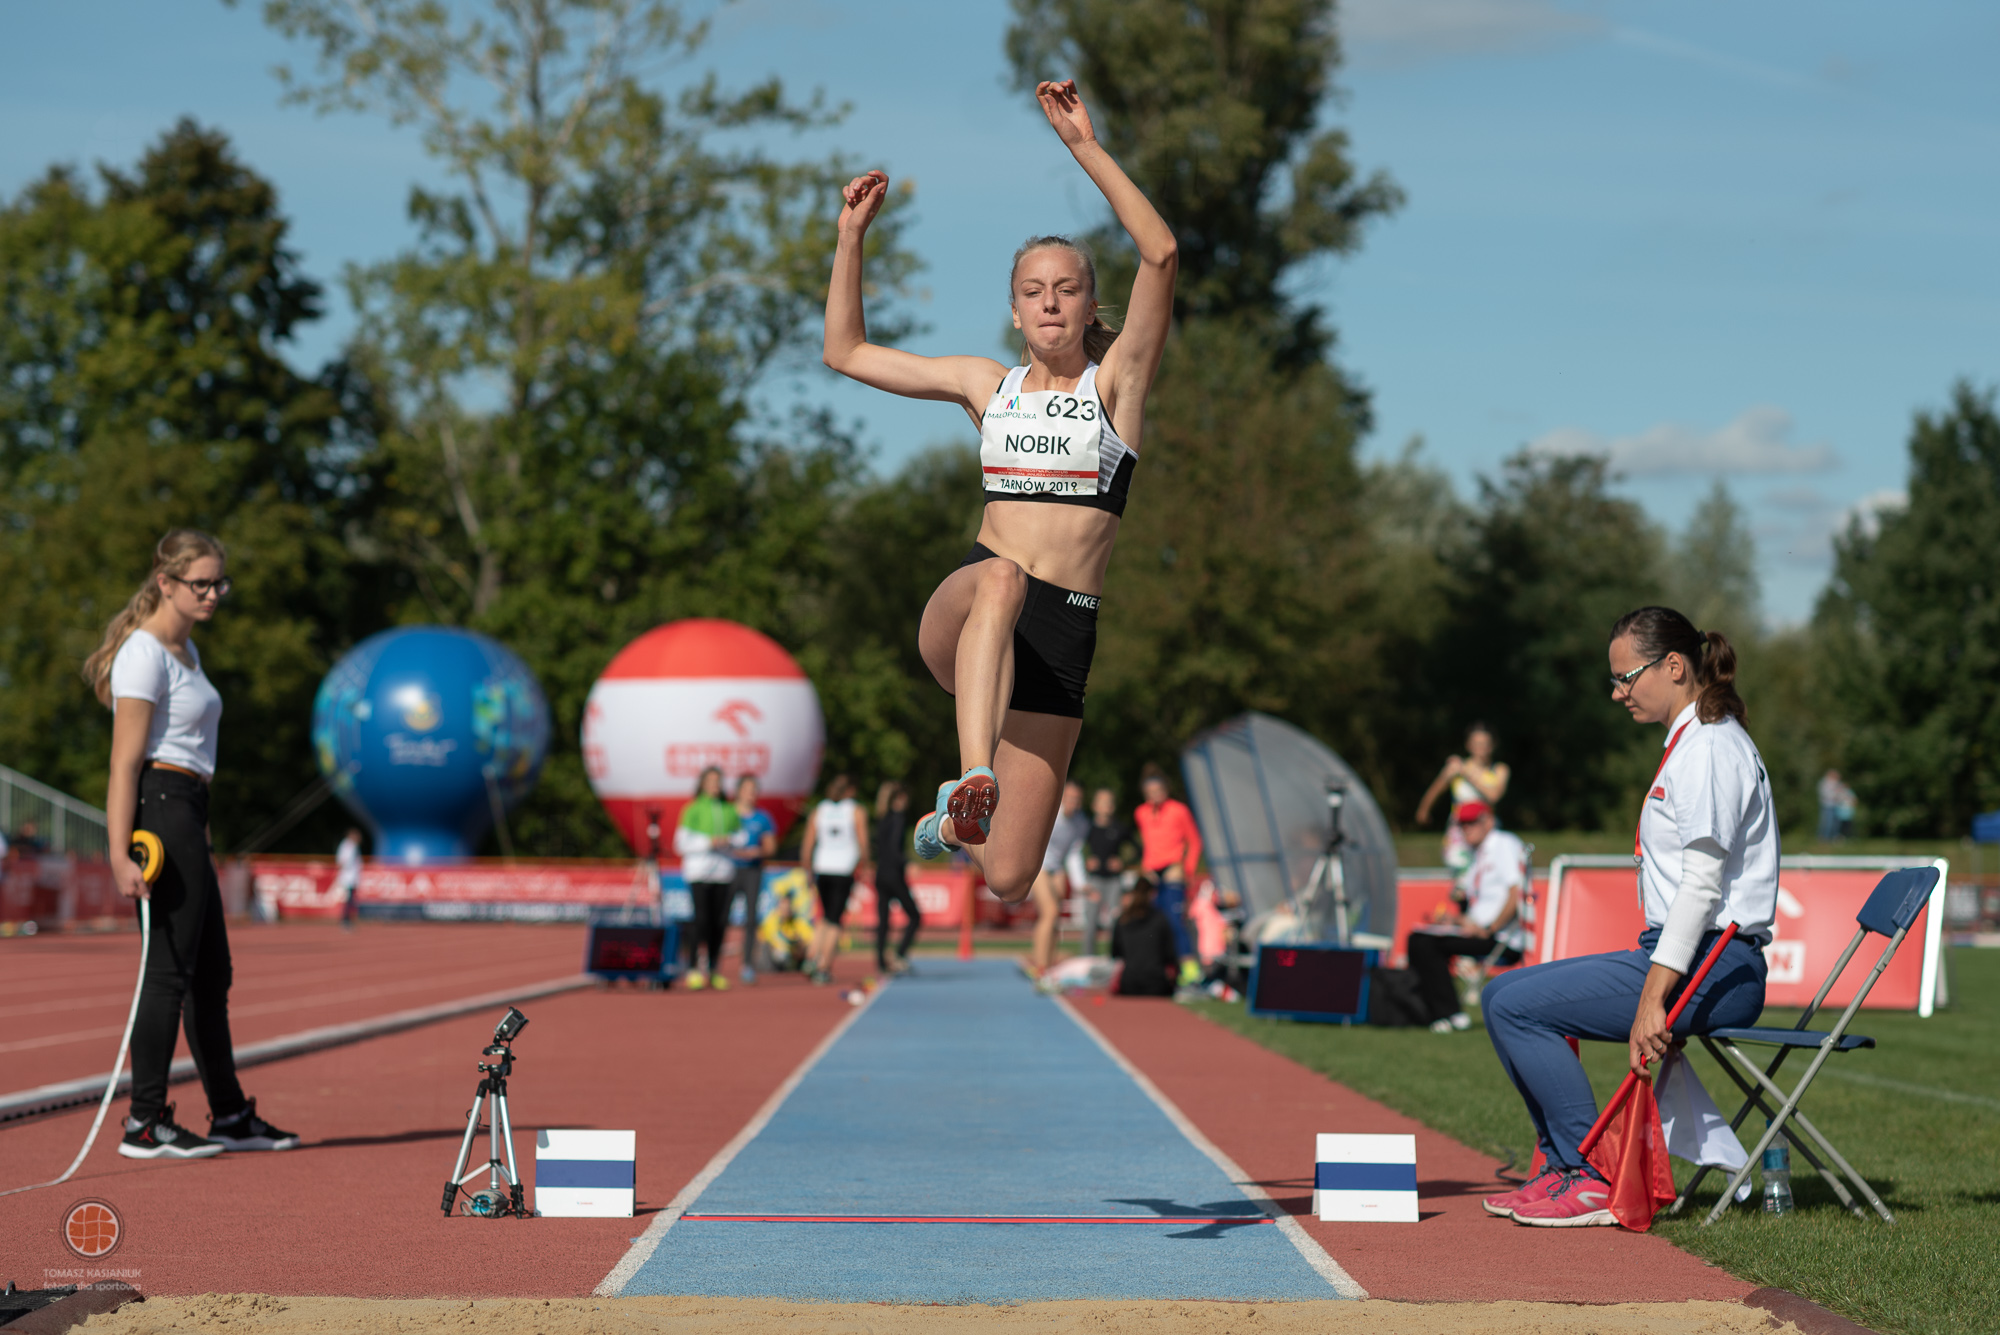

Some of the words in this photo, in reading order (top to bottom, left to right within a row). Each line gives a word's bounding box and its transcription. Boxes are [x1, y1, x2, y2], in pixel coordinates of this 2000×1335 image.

[987, 411, 1037, 420] MAŁOPOLSKA
[1046, 395, 1097, 421] 623
[1005, 434, 1071, 455] NOBIK
[1000, 478, 1045, 491] TARNÓW
[1049, 481, 1078, 494] 2019
[1066, 592, 1097, 610] NIKE
